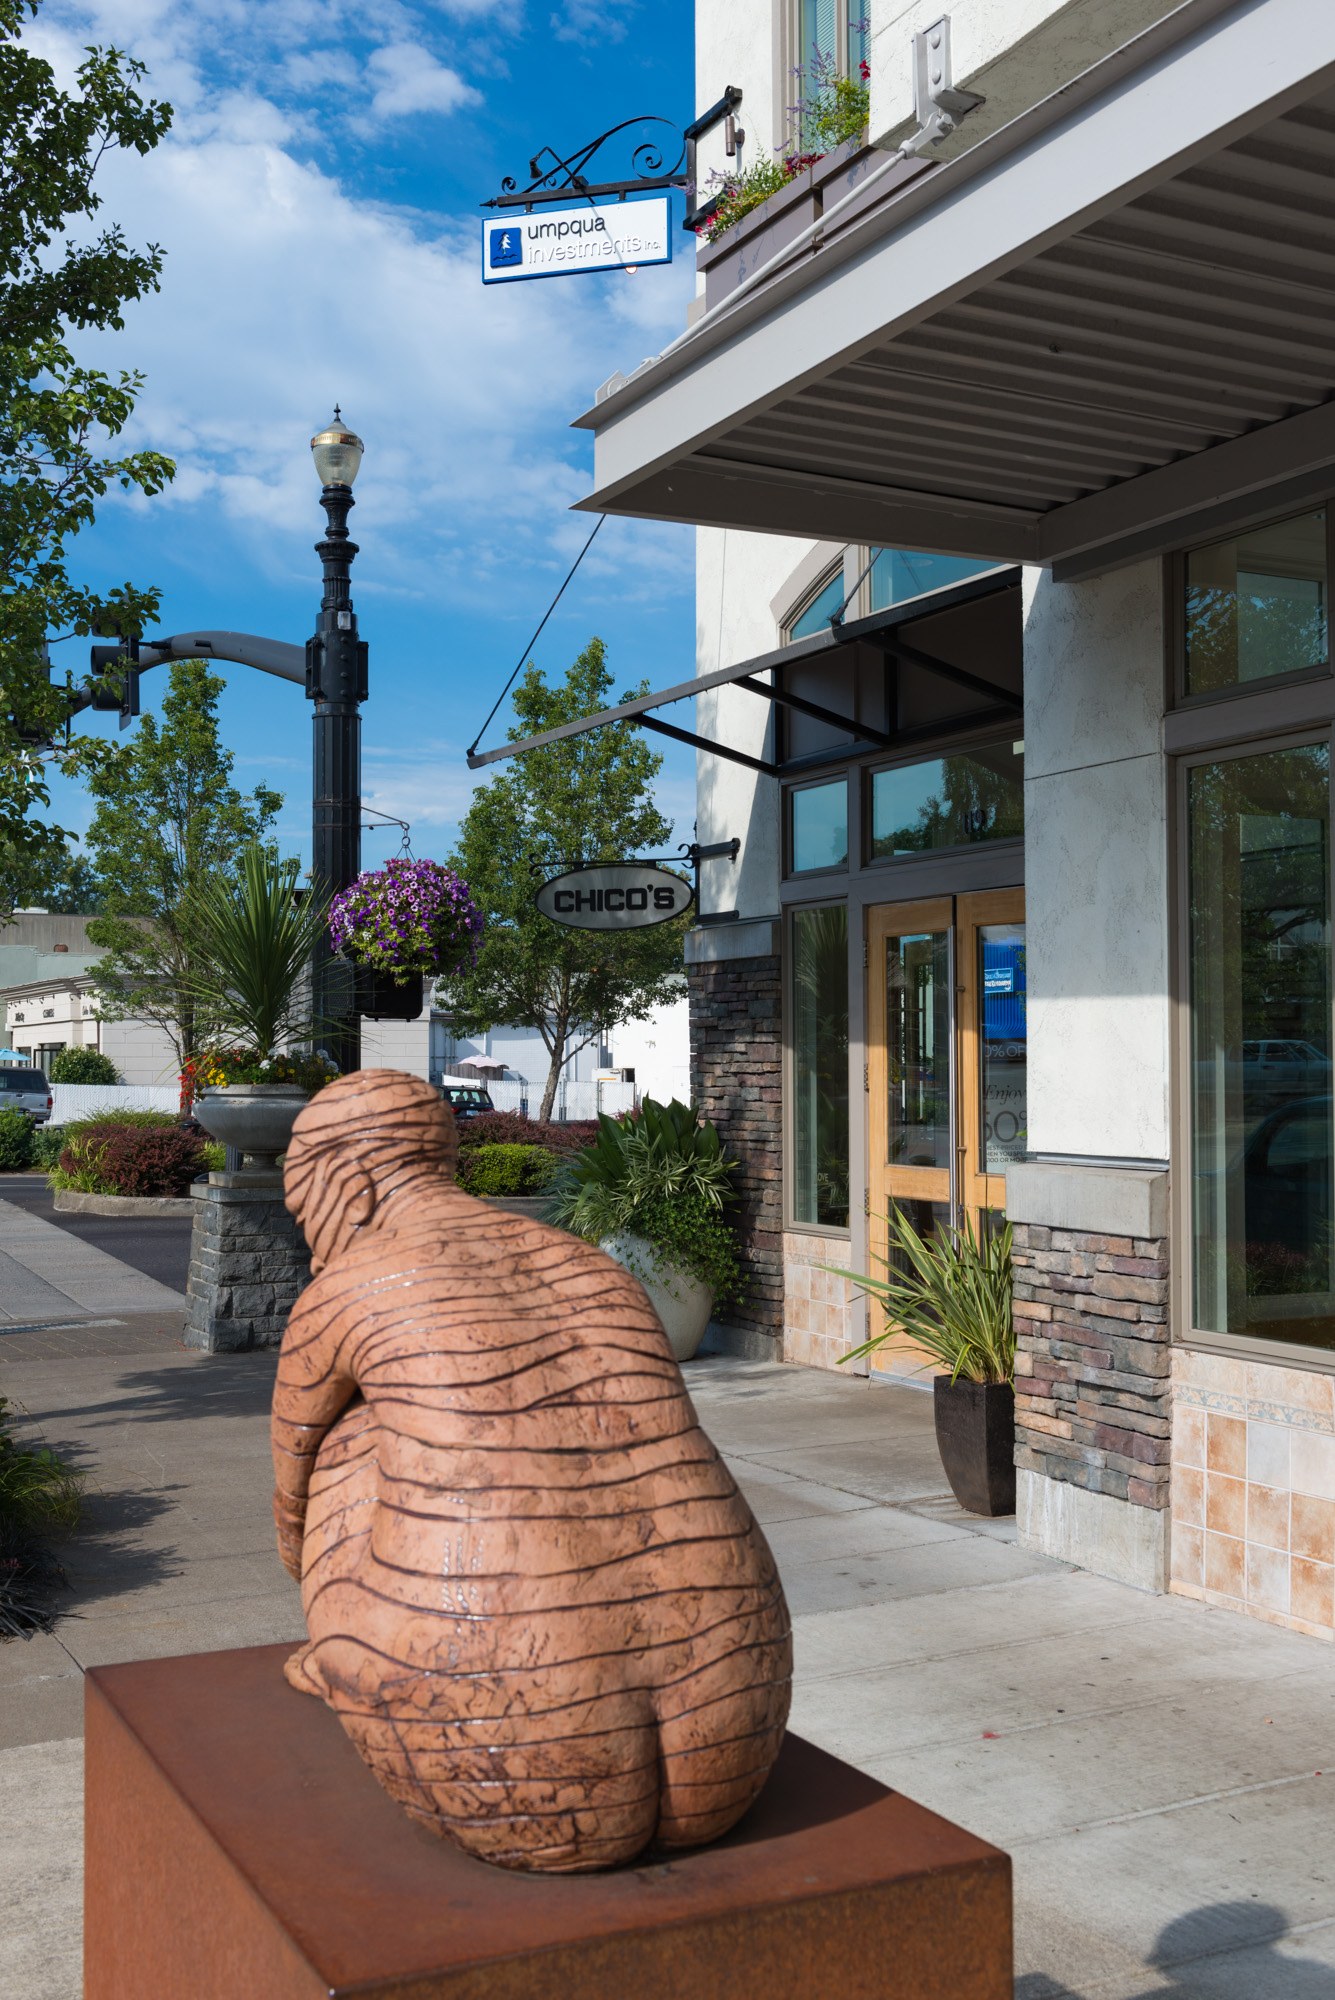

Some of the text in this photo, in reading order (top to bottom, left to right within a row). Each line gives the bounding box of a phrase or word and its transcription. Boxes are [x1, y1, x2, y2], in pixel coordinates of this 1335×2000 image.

[527, 217, 606, 240] umpqua
[528, 234, 641, 264] investments
[554, 884, 675, 913] CHICO'S
